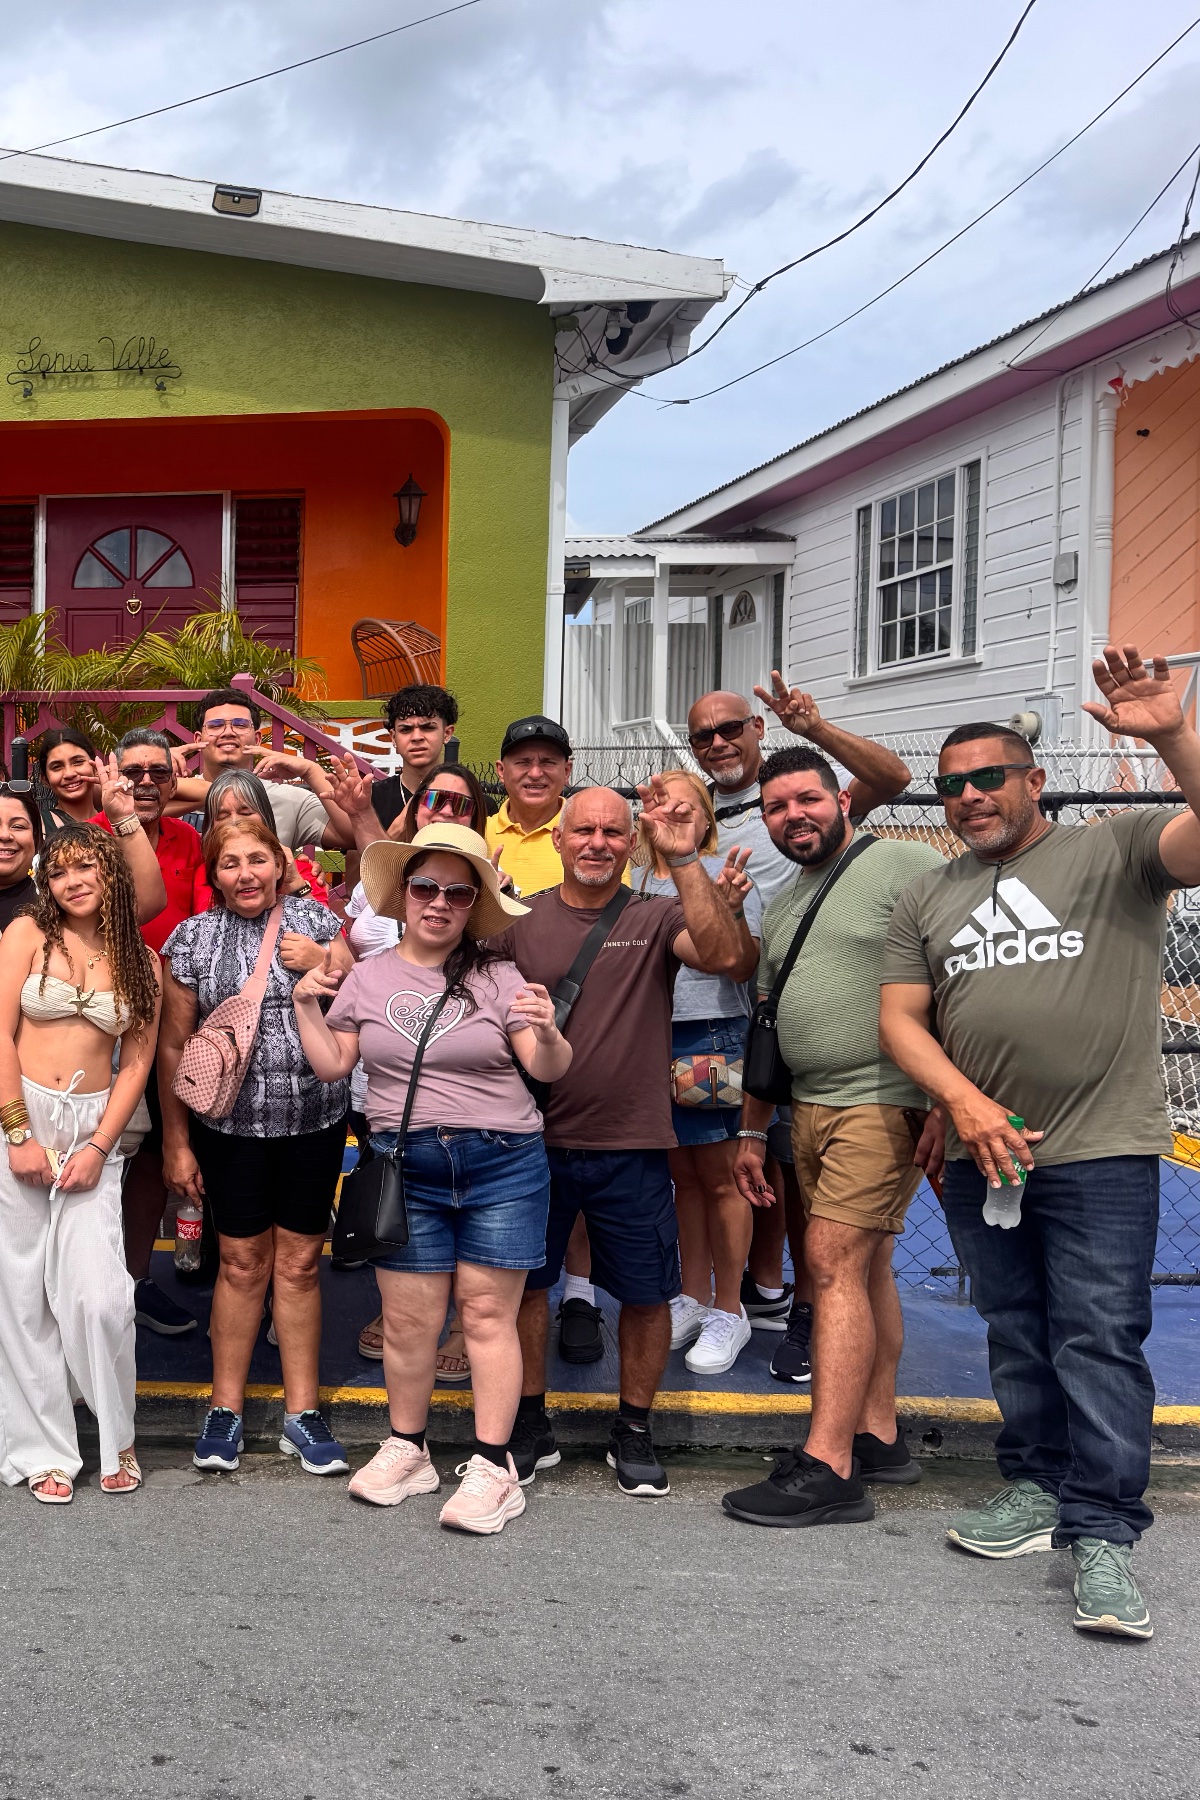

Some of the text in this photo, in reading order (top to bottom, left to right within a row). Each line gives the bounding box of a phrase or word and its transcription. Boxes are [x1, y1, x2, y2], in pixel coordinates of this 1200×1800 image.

[98, 336, 172, 370] Ville
[602, 941, 630, 949] ENNETH
[944, 929, 1085, 978] adidas
[393, 1002, 453, 1019] Aeo
